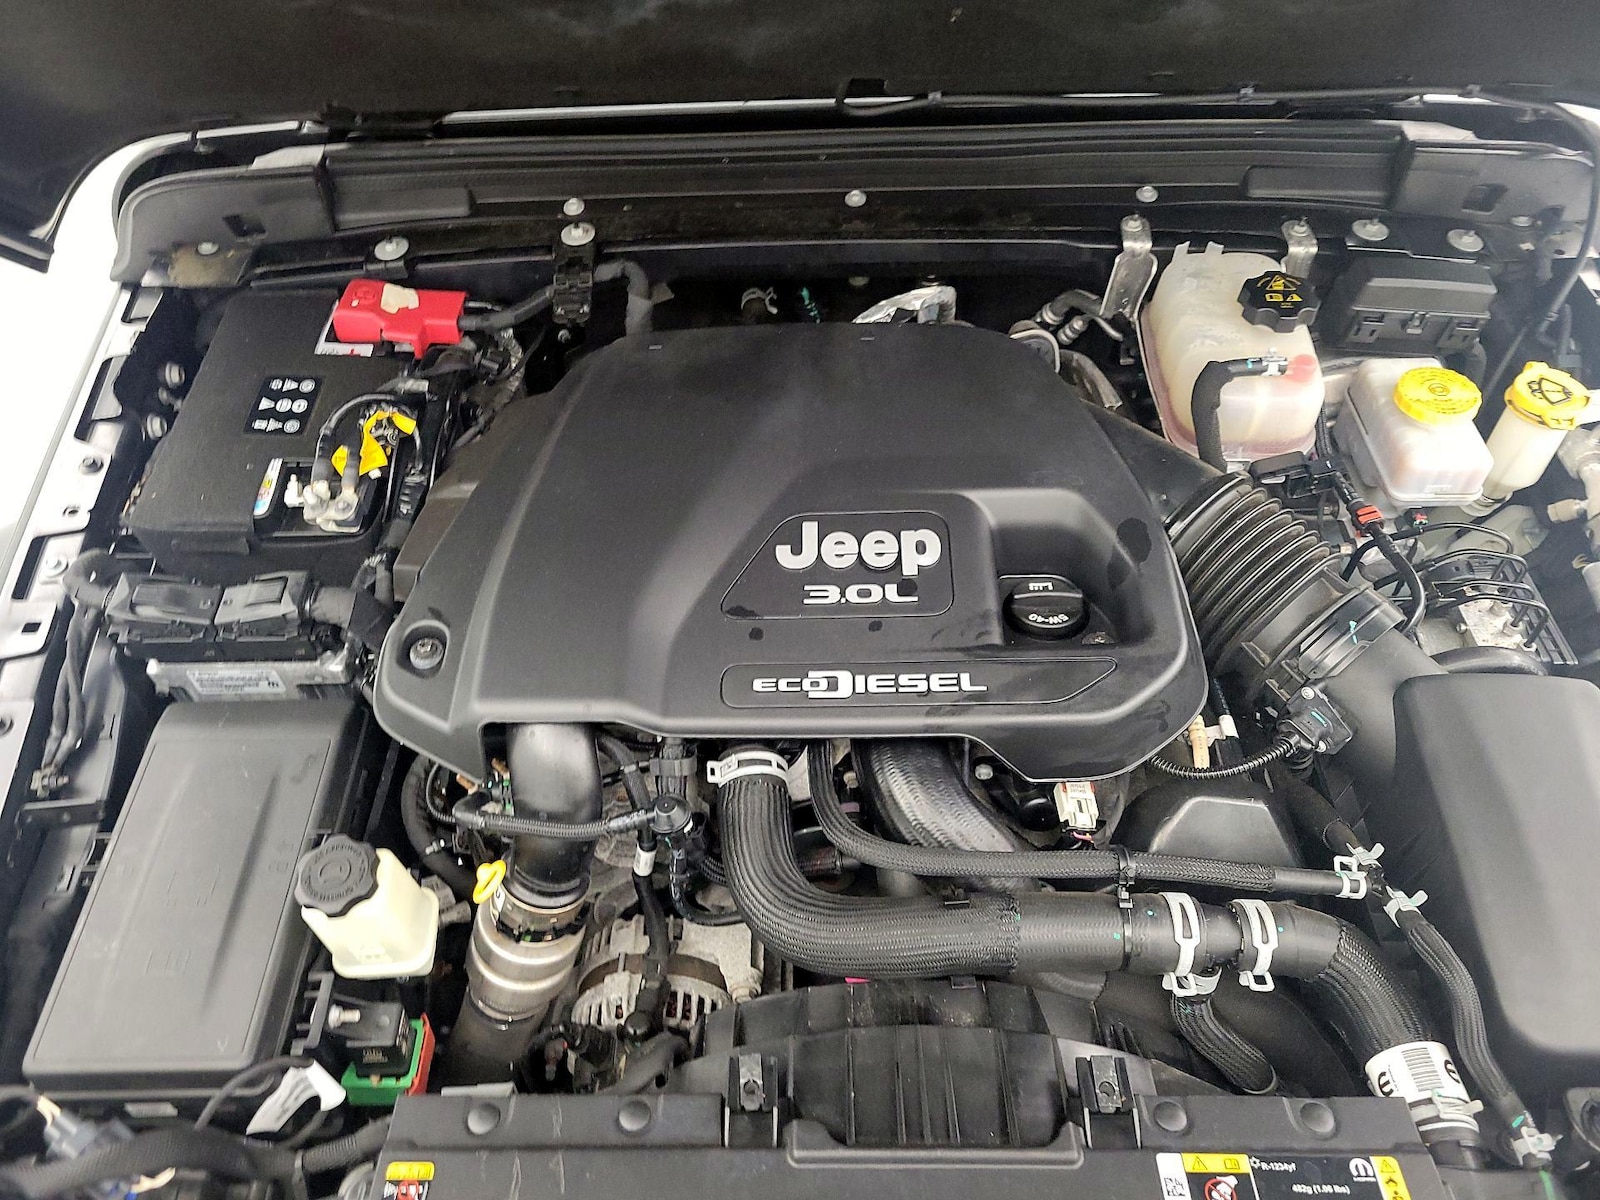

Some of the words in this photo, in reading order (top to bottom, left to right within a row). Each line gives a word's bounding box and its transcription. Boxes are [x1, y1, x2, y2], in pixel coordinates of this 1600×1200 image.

[775, 521, 941, 577] Jeep
[803, 583, 919, 605] 3.0L
[1028, 613, 1069, 625] 5W-40
